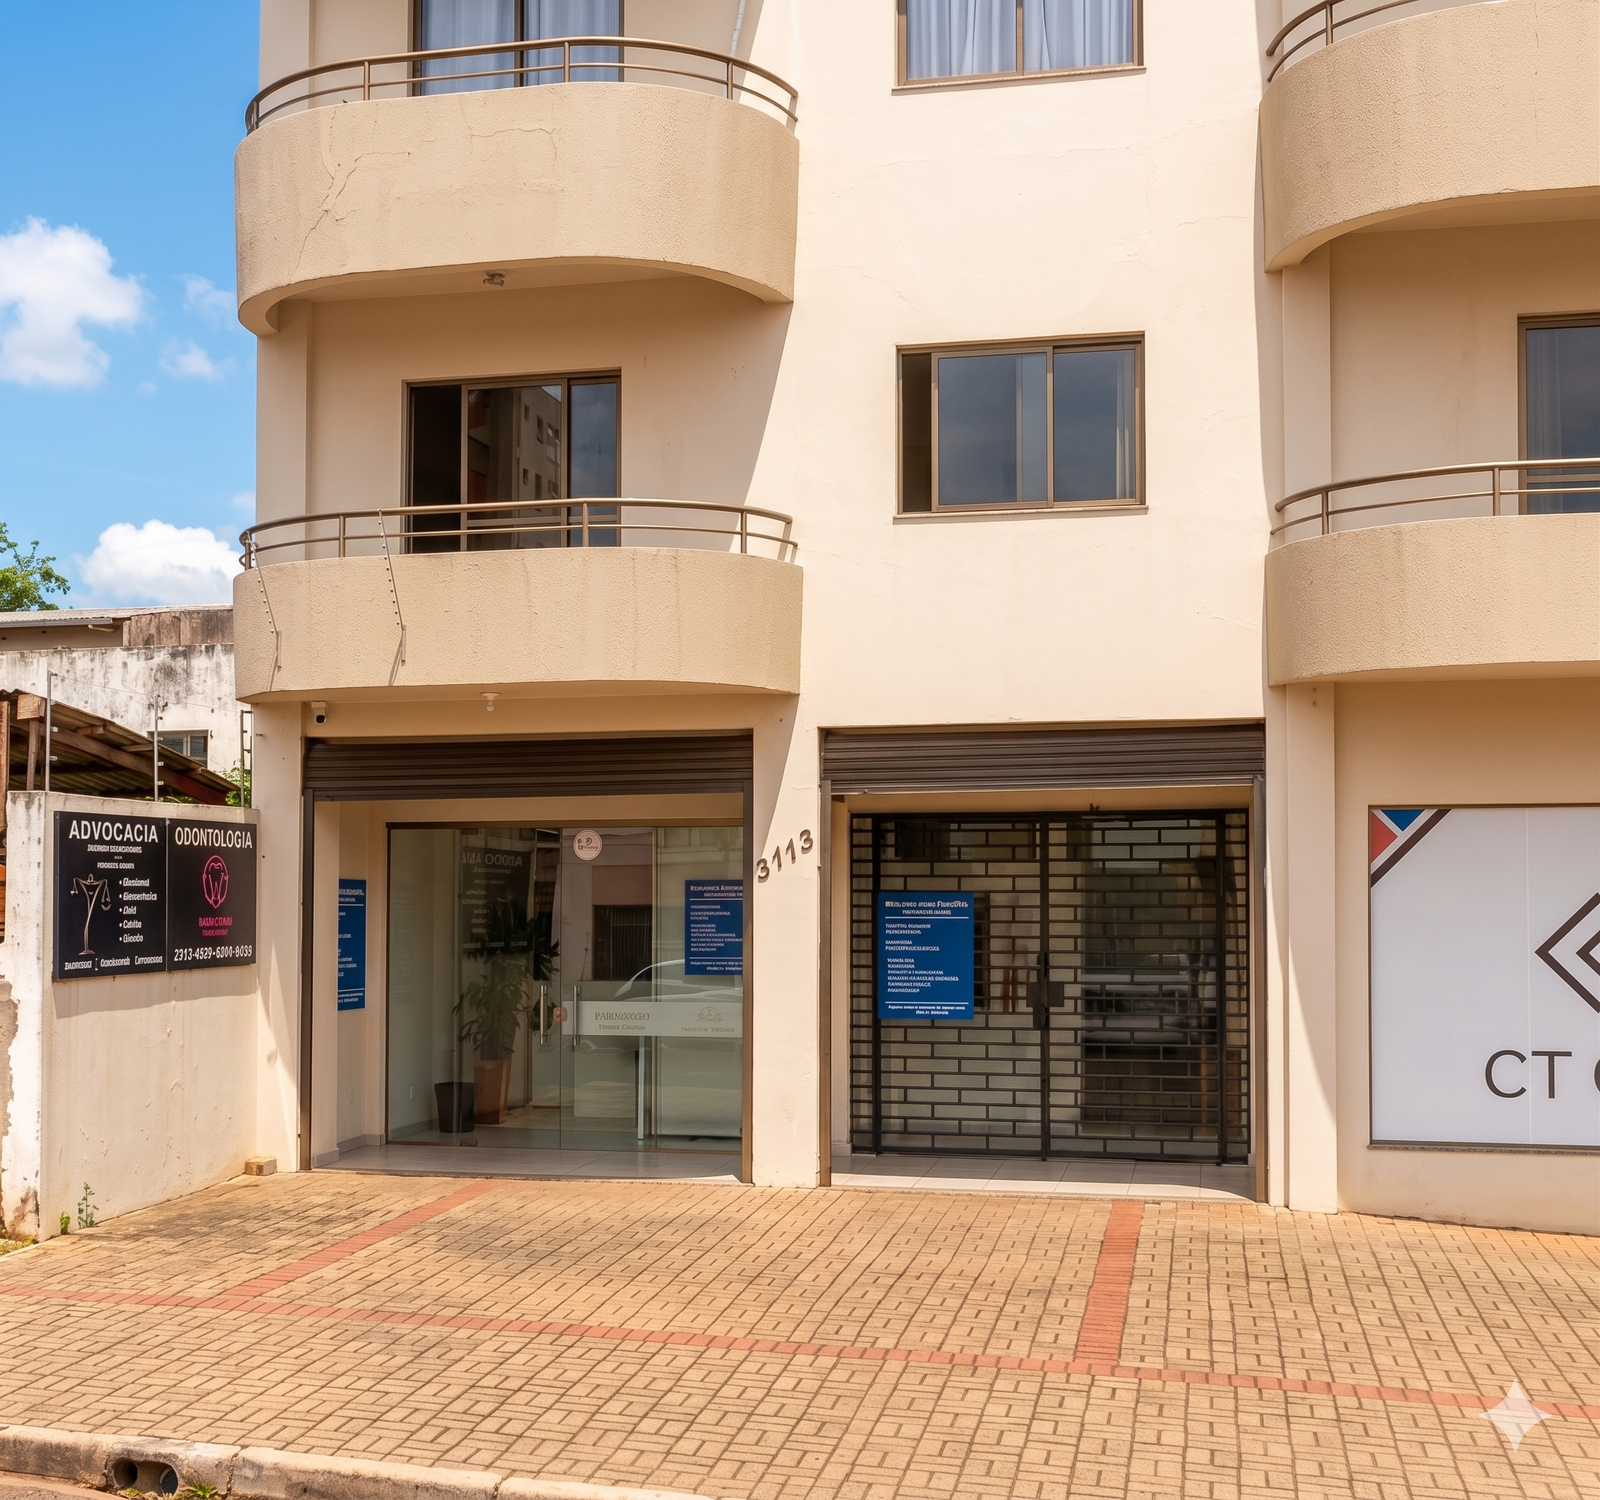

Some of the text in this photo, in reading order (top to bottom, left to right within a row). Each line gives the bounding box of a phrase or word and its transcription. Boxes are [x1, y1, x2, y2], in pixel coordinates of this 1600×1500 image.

[68, 819, 159, 843] ADVOCACIA
[174, 826, 253, 849] ODONTOLOGIA
[756, 828, 814, 883] 3113
[1484, 1049, 1573, 1099] CT
